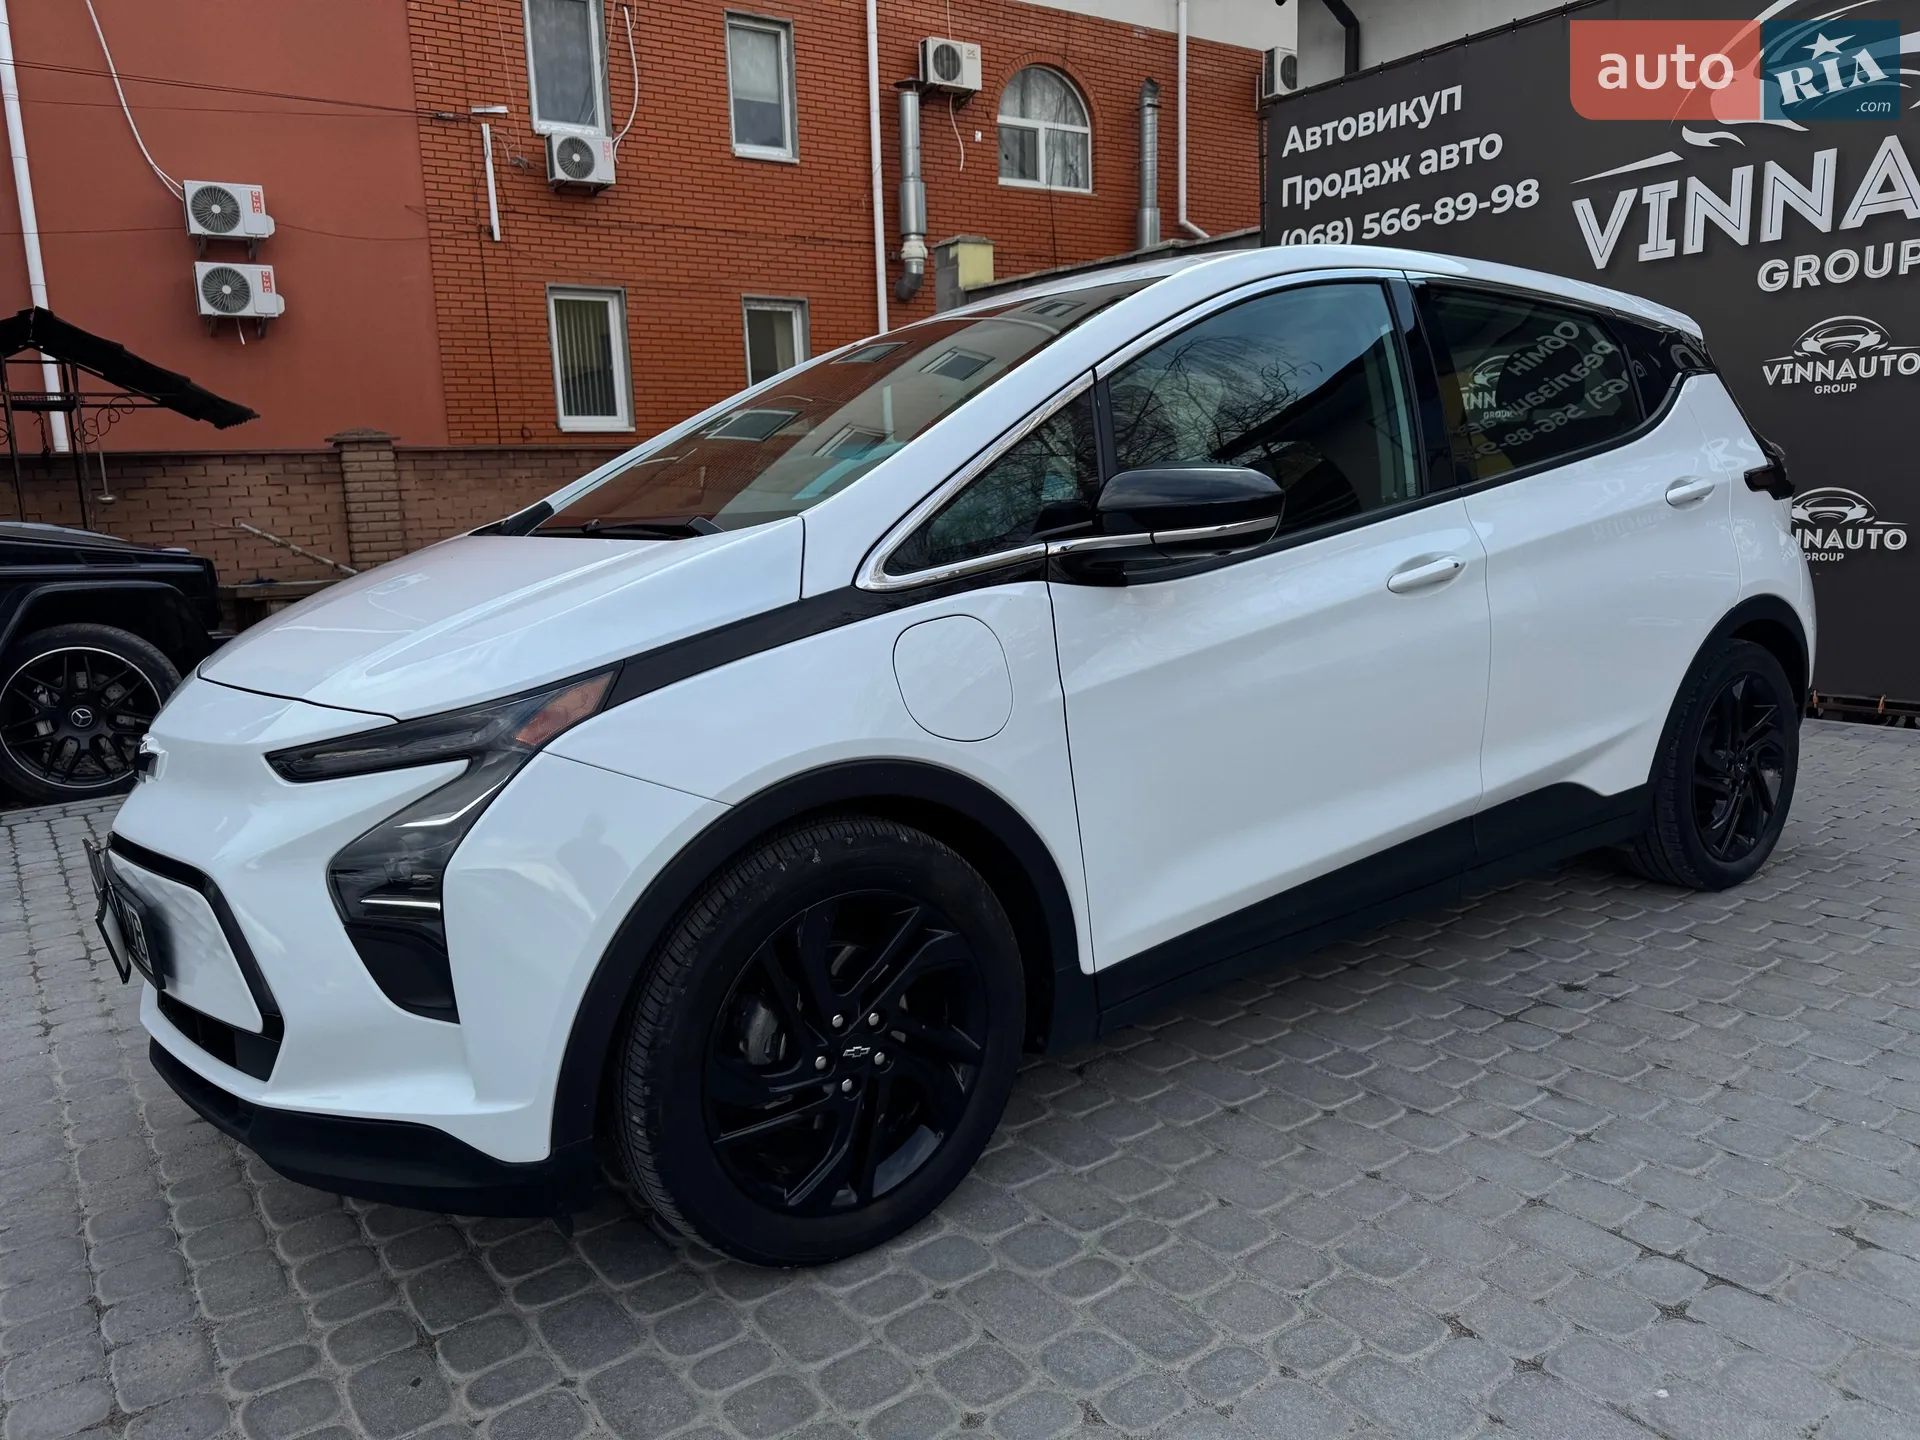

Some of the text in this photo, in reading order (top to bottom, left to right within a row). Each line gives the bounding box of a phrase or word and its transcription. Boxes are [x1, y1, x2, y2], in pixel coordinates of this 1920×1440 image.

[1281, 84, 1463, 158] Автовикуп
[1281, 132, 1504, 210] Продаж авто
[1280, 178, 1541, 246] (068) 566-89-98
[1757, 238, 1920, 292] GROUP
[1762, 352, 1920, 386] VINNAUTO
[1814, 382, 1857, 395] GROUP
[1795, 528, 1908, 551] NAUTO
